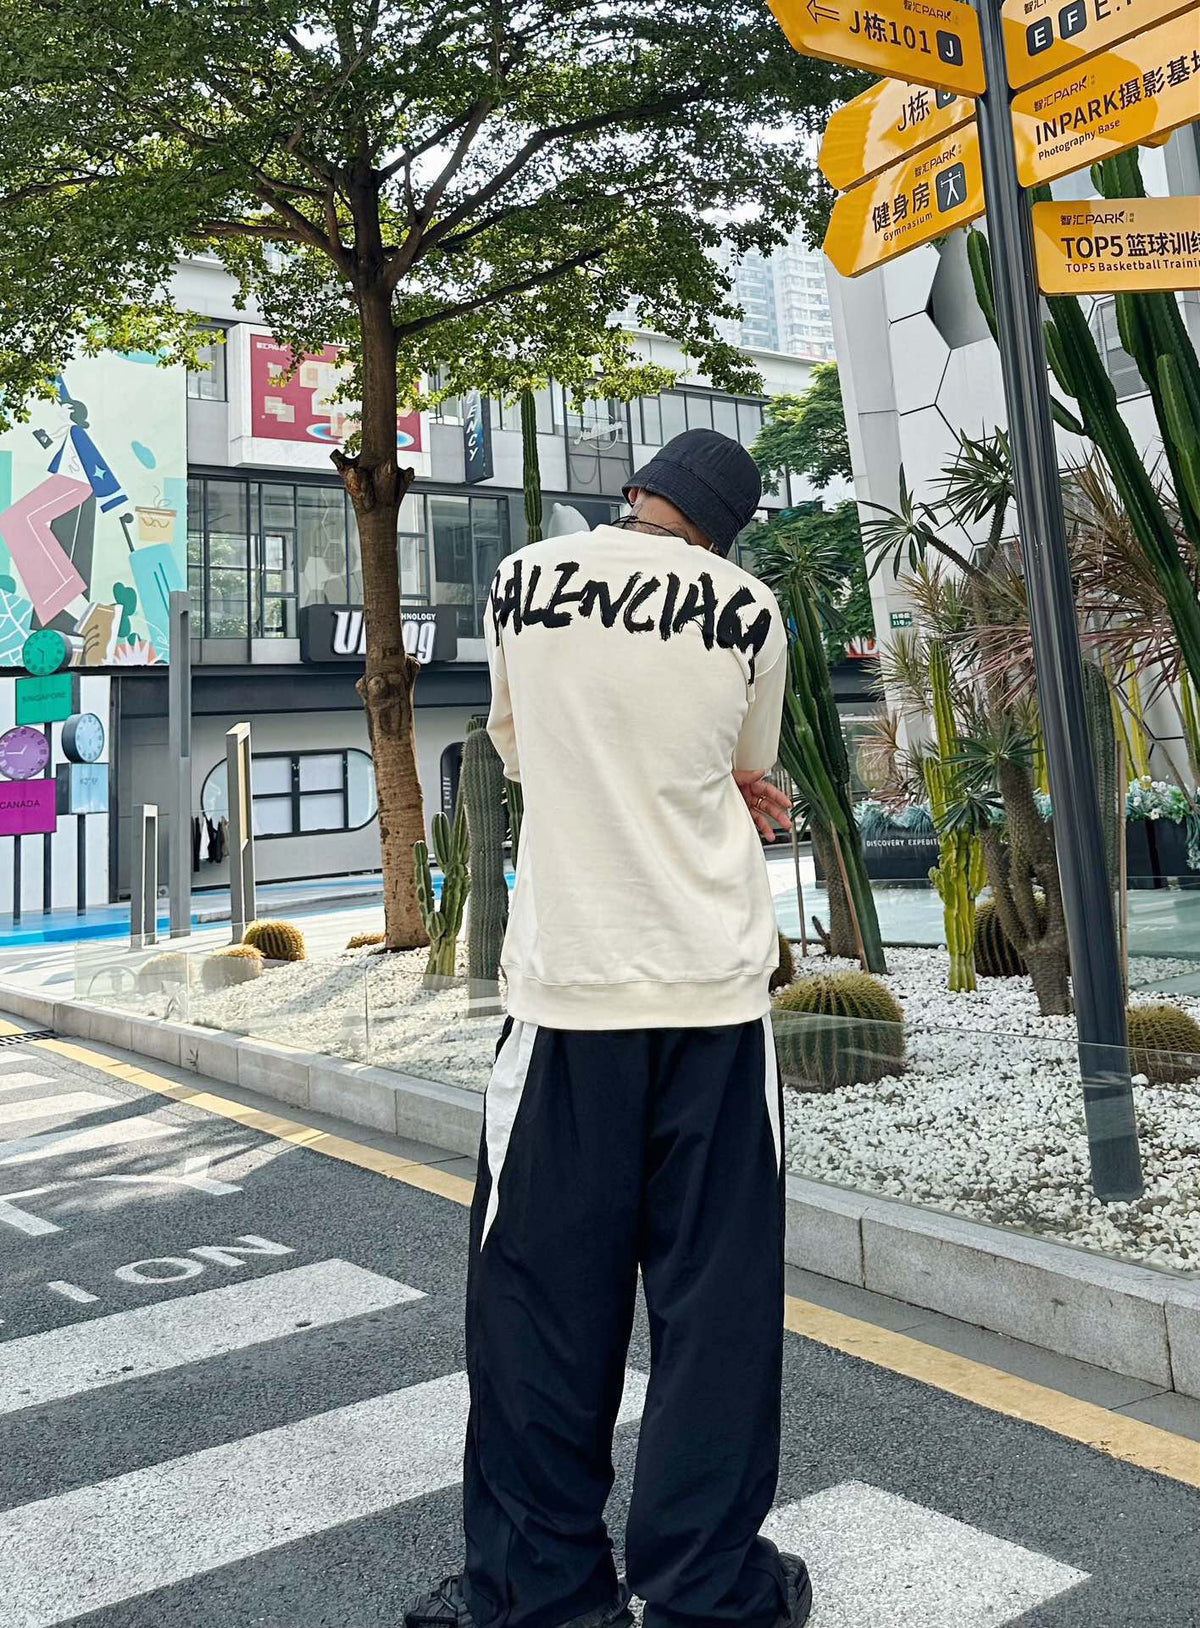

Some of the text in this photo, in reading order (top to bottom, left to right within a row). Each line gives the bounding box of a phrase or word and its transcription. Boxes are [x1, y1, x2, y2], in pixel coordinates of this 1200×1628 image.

[1067, 9, 1079, 31] F
[1034, 27, 1047, 48] E
[945, 40, 954, 58] J
[1034, 75, 1088, 112] 智汇PARK
[897, 90, 931, 131] J栋
[1038, 118, 1121, 161] Photography Base
[914, 145, 957, 178] 智汇PARK
[872, 181, 932, 234] 健身房
[1060, 210, 1126, 226] 智汇PARK
[883, 212, 933, 242] Gymnasium
[1066, 263, 1096, 273] TOP5
[1099, 259, 1161, 272] Basketball
[401, 612, 436, 621] HNOLOGY
[0, 800, 40, 809] CANADA
